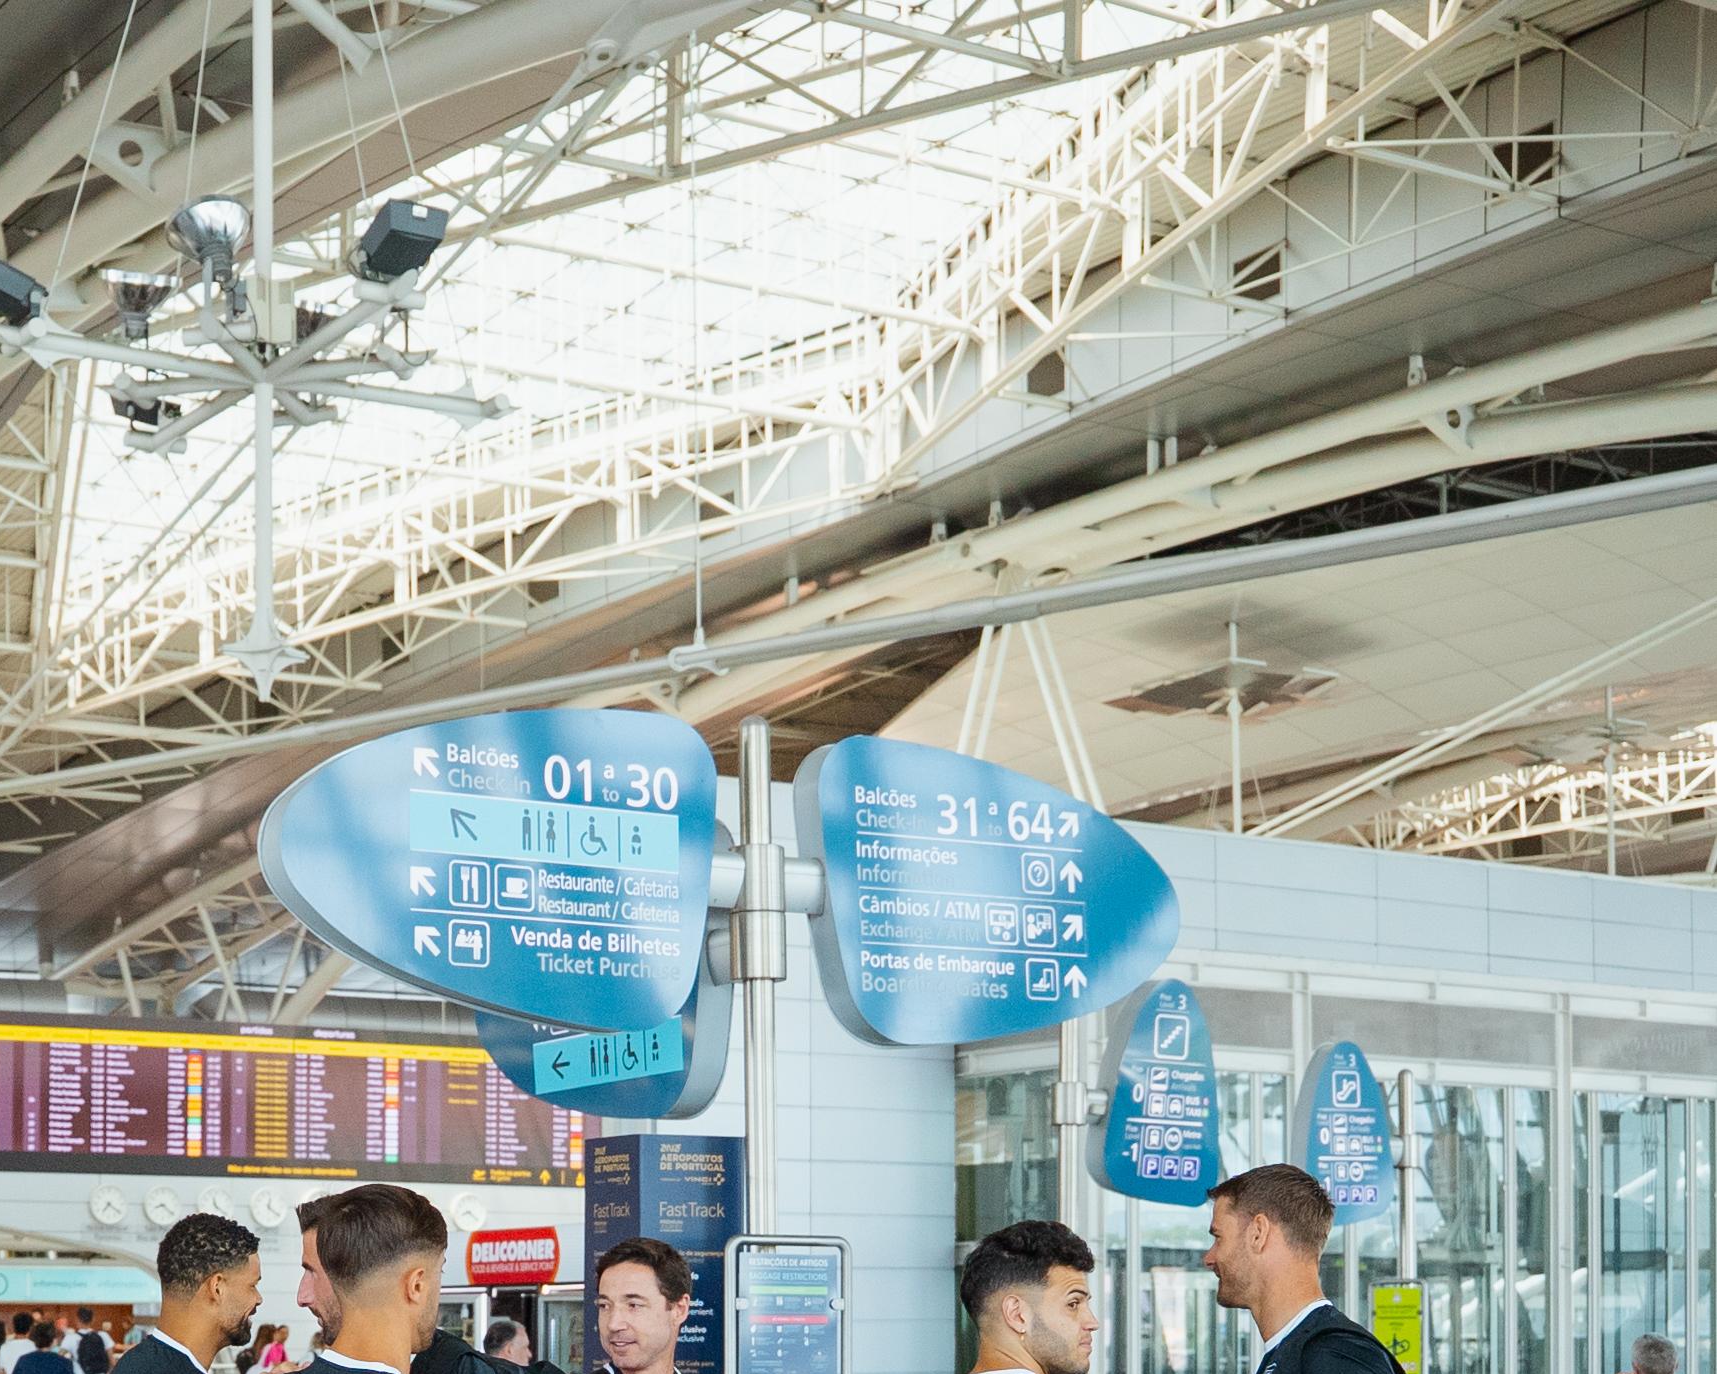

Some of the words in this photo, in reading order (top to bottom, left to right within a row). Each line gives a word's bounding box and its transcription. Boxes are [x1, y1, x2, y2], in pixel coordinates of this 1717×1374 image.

[447, 743, 519, 769] Balcões
[543, 754, 593, 803] 01
[603, 763, 615, 780] a
[626, 763, 679, 811] 30
[602, 786, 620, 803] to
[854, 785, 917, 808] Balcões
[937, 794, 978, 837] 31
[988, 802, 998, 816] a
[1007, 801, 1054, 843] 64
[856, 840, 958, 867] Informações
[538, 869, 614, 894] Restaurante
[624, 877, 679, 899] Cafetaria
[538, 895, 610, 918] Restaurant
[621, 902, 680, 924] Cafeteria
[858, 895, 930, 917] Câmbios
[944, 901, 980, 920] ATM
[510, 925, 572, 950] Venda
[578, 930, 602, 951] de
[608, 933, 681, 957] Bilhetes
[860, 920, 932, 943] Exchange
[537, 952, 594, 975] Ticket
[600, 957, 680, 980] Purchse
[860, 950, 910, 971] Portas
[914, 953, 934, 971] de
[937, 955, 1015, 978] Embarque
[1178, 994, 1187, 1010] 3
[1348, 1054, 1356, 1067] 3
[1132, 1083, 1144, 1103] 0
[660, 1153, 723, 1163] AEROPORTOS
[660, 1162, 673, 1171] DE
[675, 1162, 725, 1172] PORTUGAL
[659, 1201, 687, 1217] Fast
[687, 1201, 725, 1218] Track
[472, 1238, 555, 1263] DELICORNER
[680, 1325, 707, 1334] clusivo
